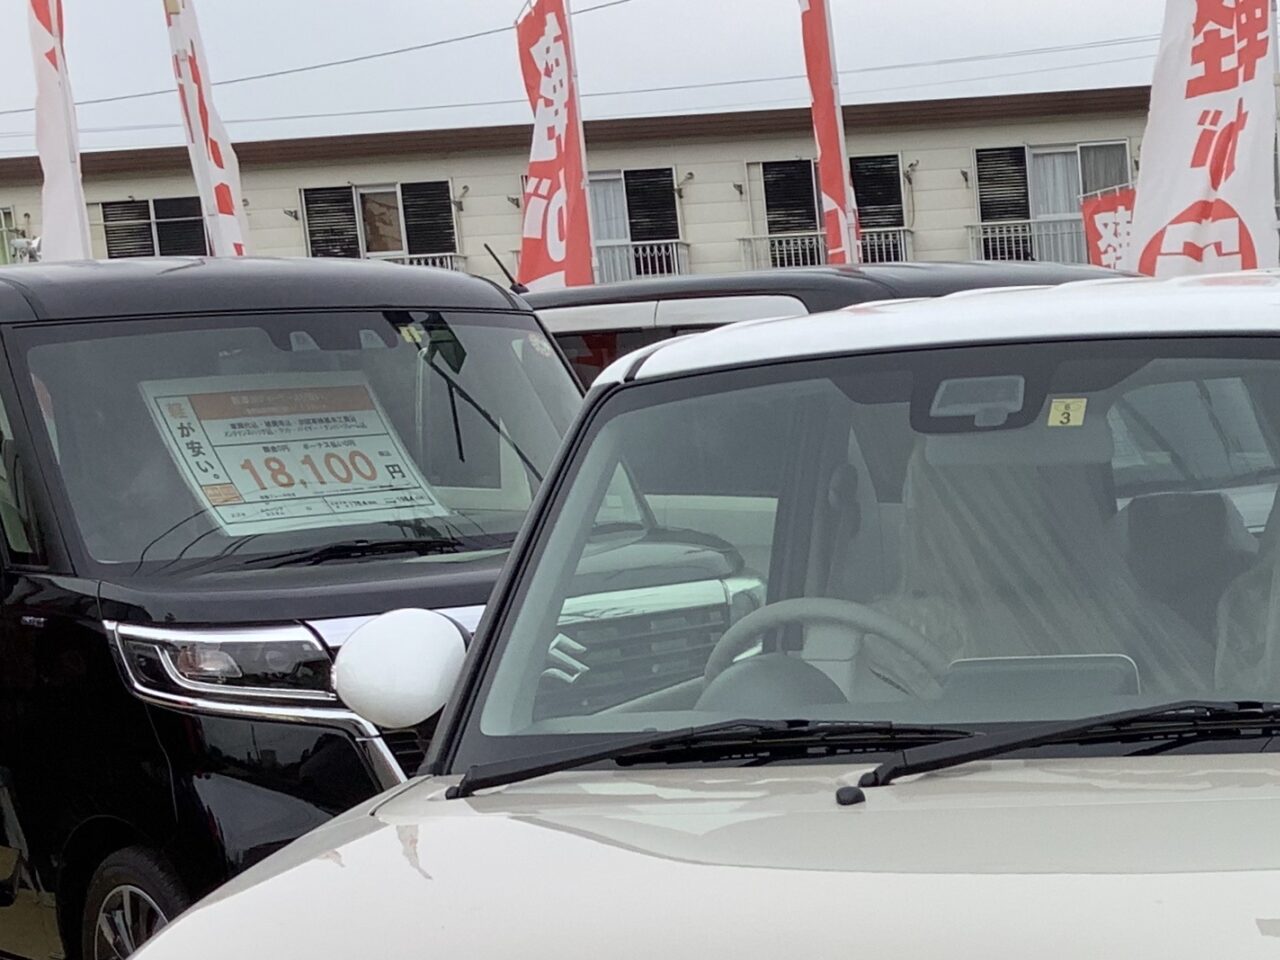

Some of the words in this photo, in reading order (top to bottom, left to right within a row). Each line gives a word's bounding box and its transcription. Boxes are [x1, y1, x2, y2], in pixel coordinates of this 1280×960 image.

[1059, 411, 1071, 425] 3
[240, 449, 378, 491] 18,100
[384, 463, 406, 480] 円
